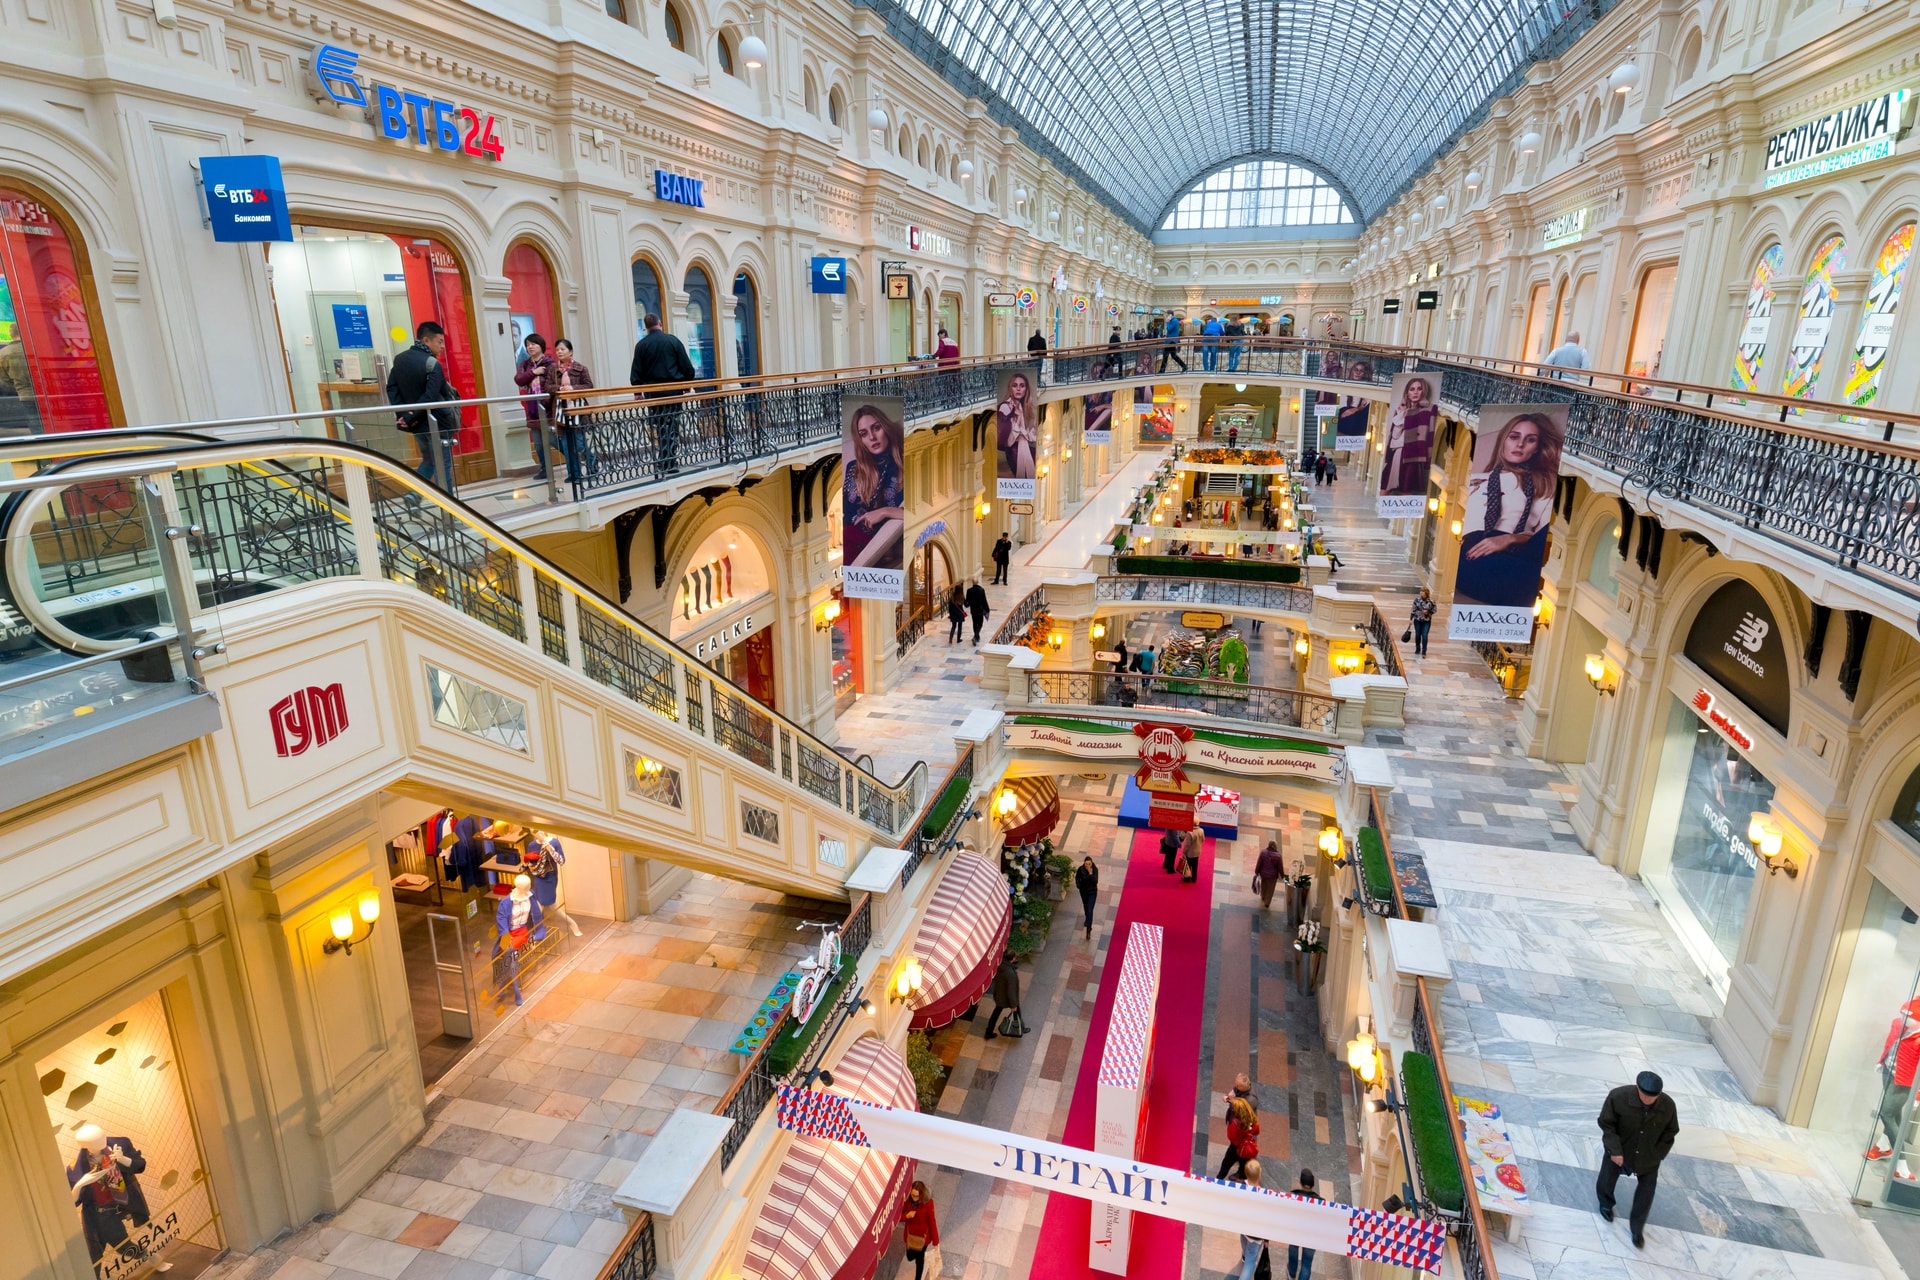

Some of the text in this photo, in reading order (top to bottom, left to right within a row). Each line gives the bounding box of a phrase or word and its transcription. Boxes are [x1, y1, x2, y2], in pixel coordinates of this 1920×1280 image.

[376, 84, 505, 162] ВТБ24
[1765, 93, 1891, 170] РЕСПУБЛИКА
[1788, 160, 1822, 181] МУЗЫКА
[1823, 141, 1889, 172] ПЕРСПЕКТИВА
[229, 188, 268, 204] ВТБ24
[656, 170, 705, 208] BANK
[234, 214, 271, 223] Банкомат
[921, 230, 951, 257] АПТЕКА
[696, 615, 753, 659] FALKE
[1504, 629, 1526, 637] ЭТАЖ
[1723, 641, 1764, 677] new balance
[1030, 729, 1123, 749] Главный магазин
[1153, 771, 1169, 780] GUM
[1200, 749, 1317, 771] на Красной площади
[993, 1144, 1169, 1206] ЛЕТАЙ!
[104, 1212, 178, 1279] НОВАЯ
[117, 1227, 181, 1280] оллекция
